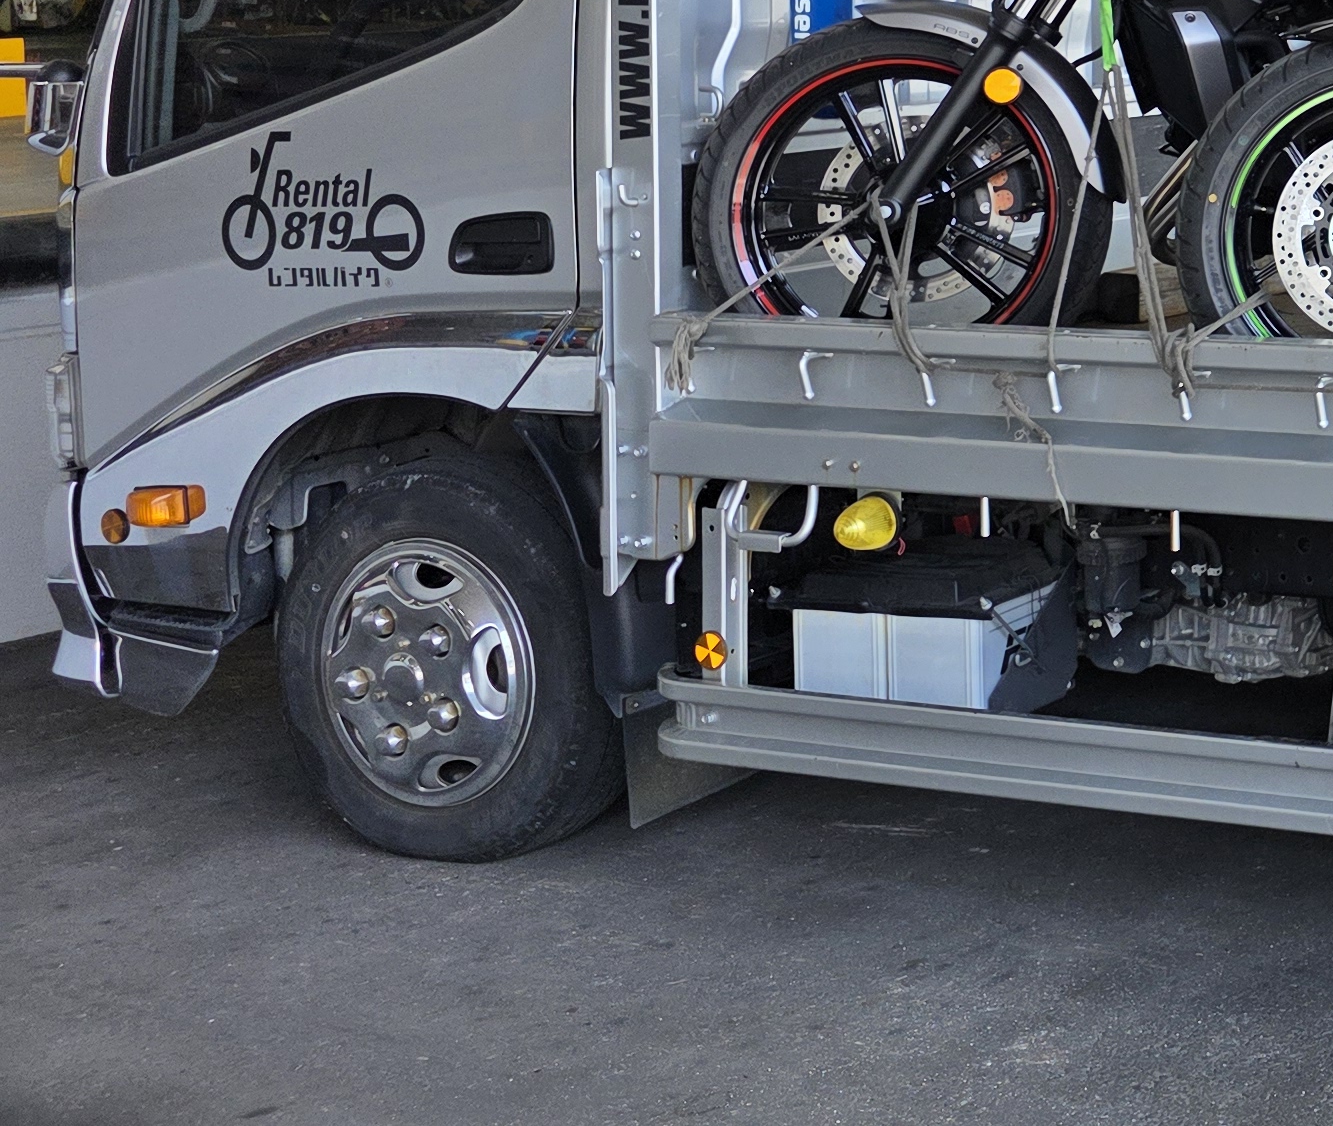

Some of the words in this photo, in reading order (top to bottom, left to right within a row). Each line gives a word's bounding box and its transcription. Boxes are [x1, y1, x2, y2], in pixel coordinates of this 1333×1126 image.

[272, 168, 373, 207] Rental
[281, 211, 354, 250] 819
[268, 266, 380, 287] レンタルバイク
